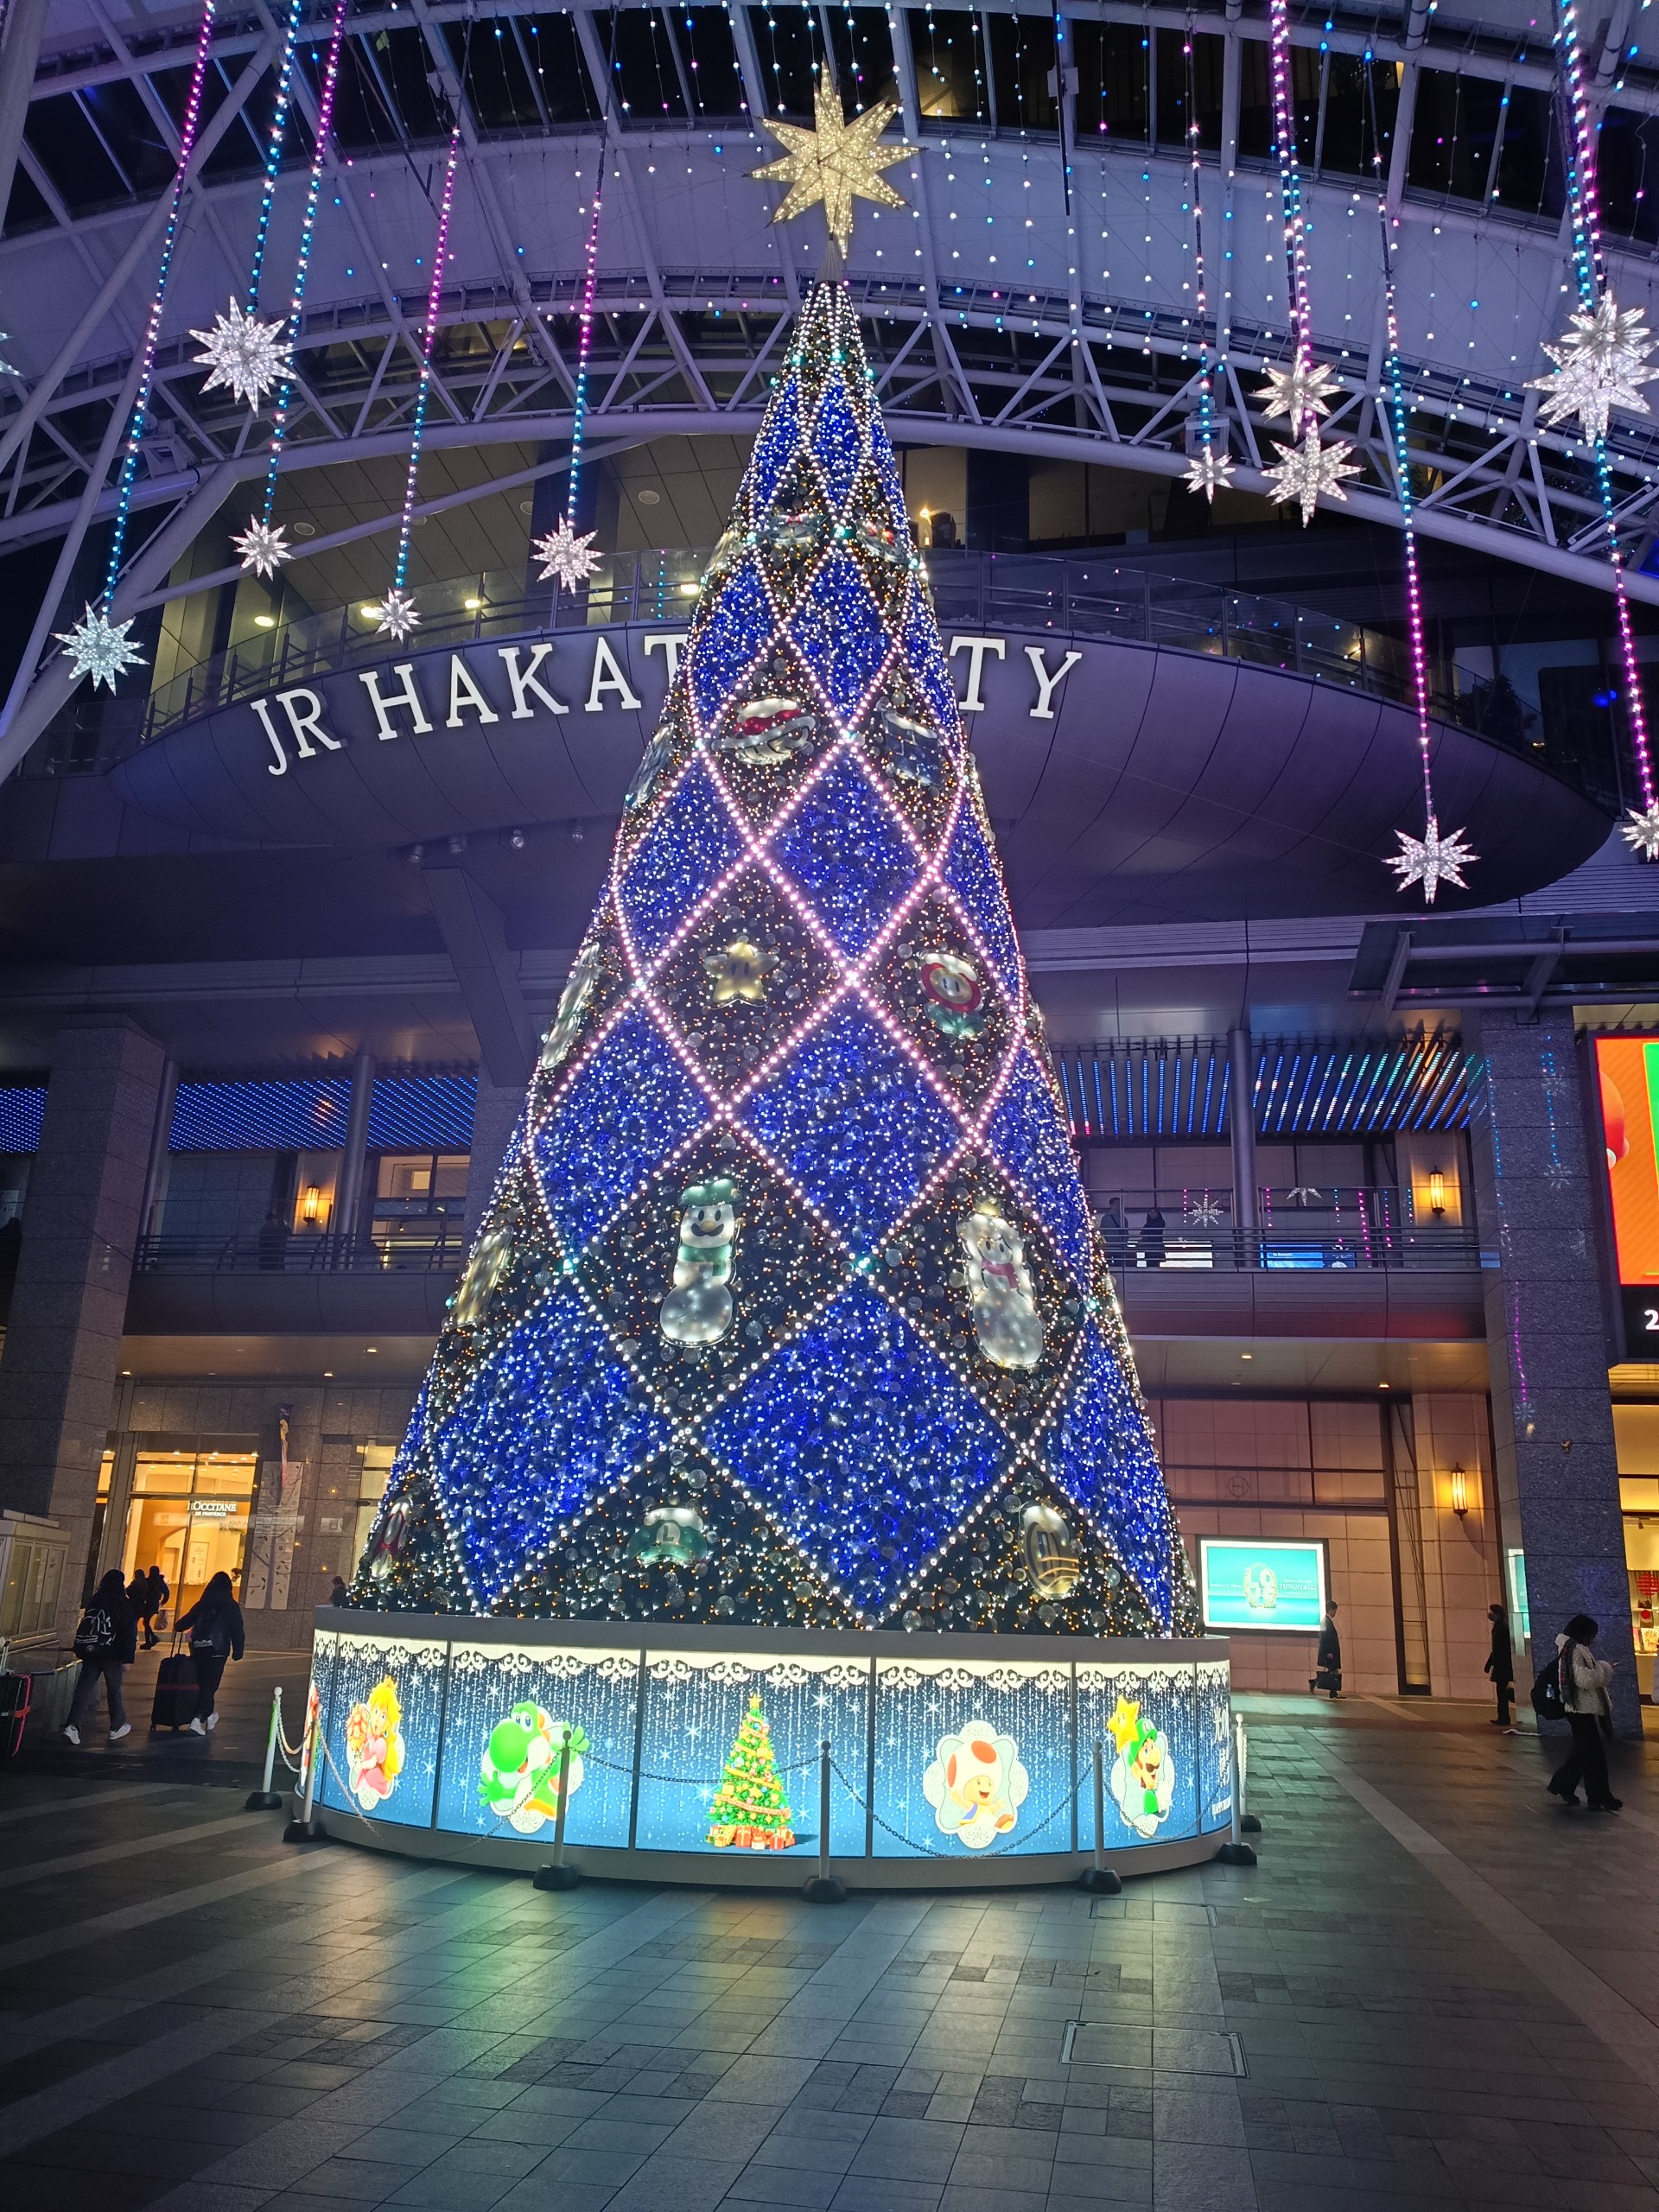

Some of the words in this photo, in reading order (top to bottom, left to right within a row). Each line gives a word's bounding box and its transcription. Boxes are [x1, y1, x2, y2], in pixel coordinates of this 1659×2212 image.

[250, 688, 342, 776] JR
[358, 633, 690, 741] HAKAT
[949, 636, 1083, 719] TY
[187, 1500, 237, 1512] LOCCITANE
[662, 1525, 675, 1541] L
